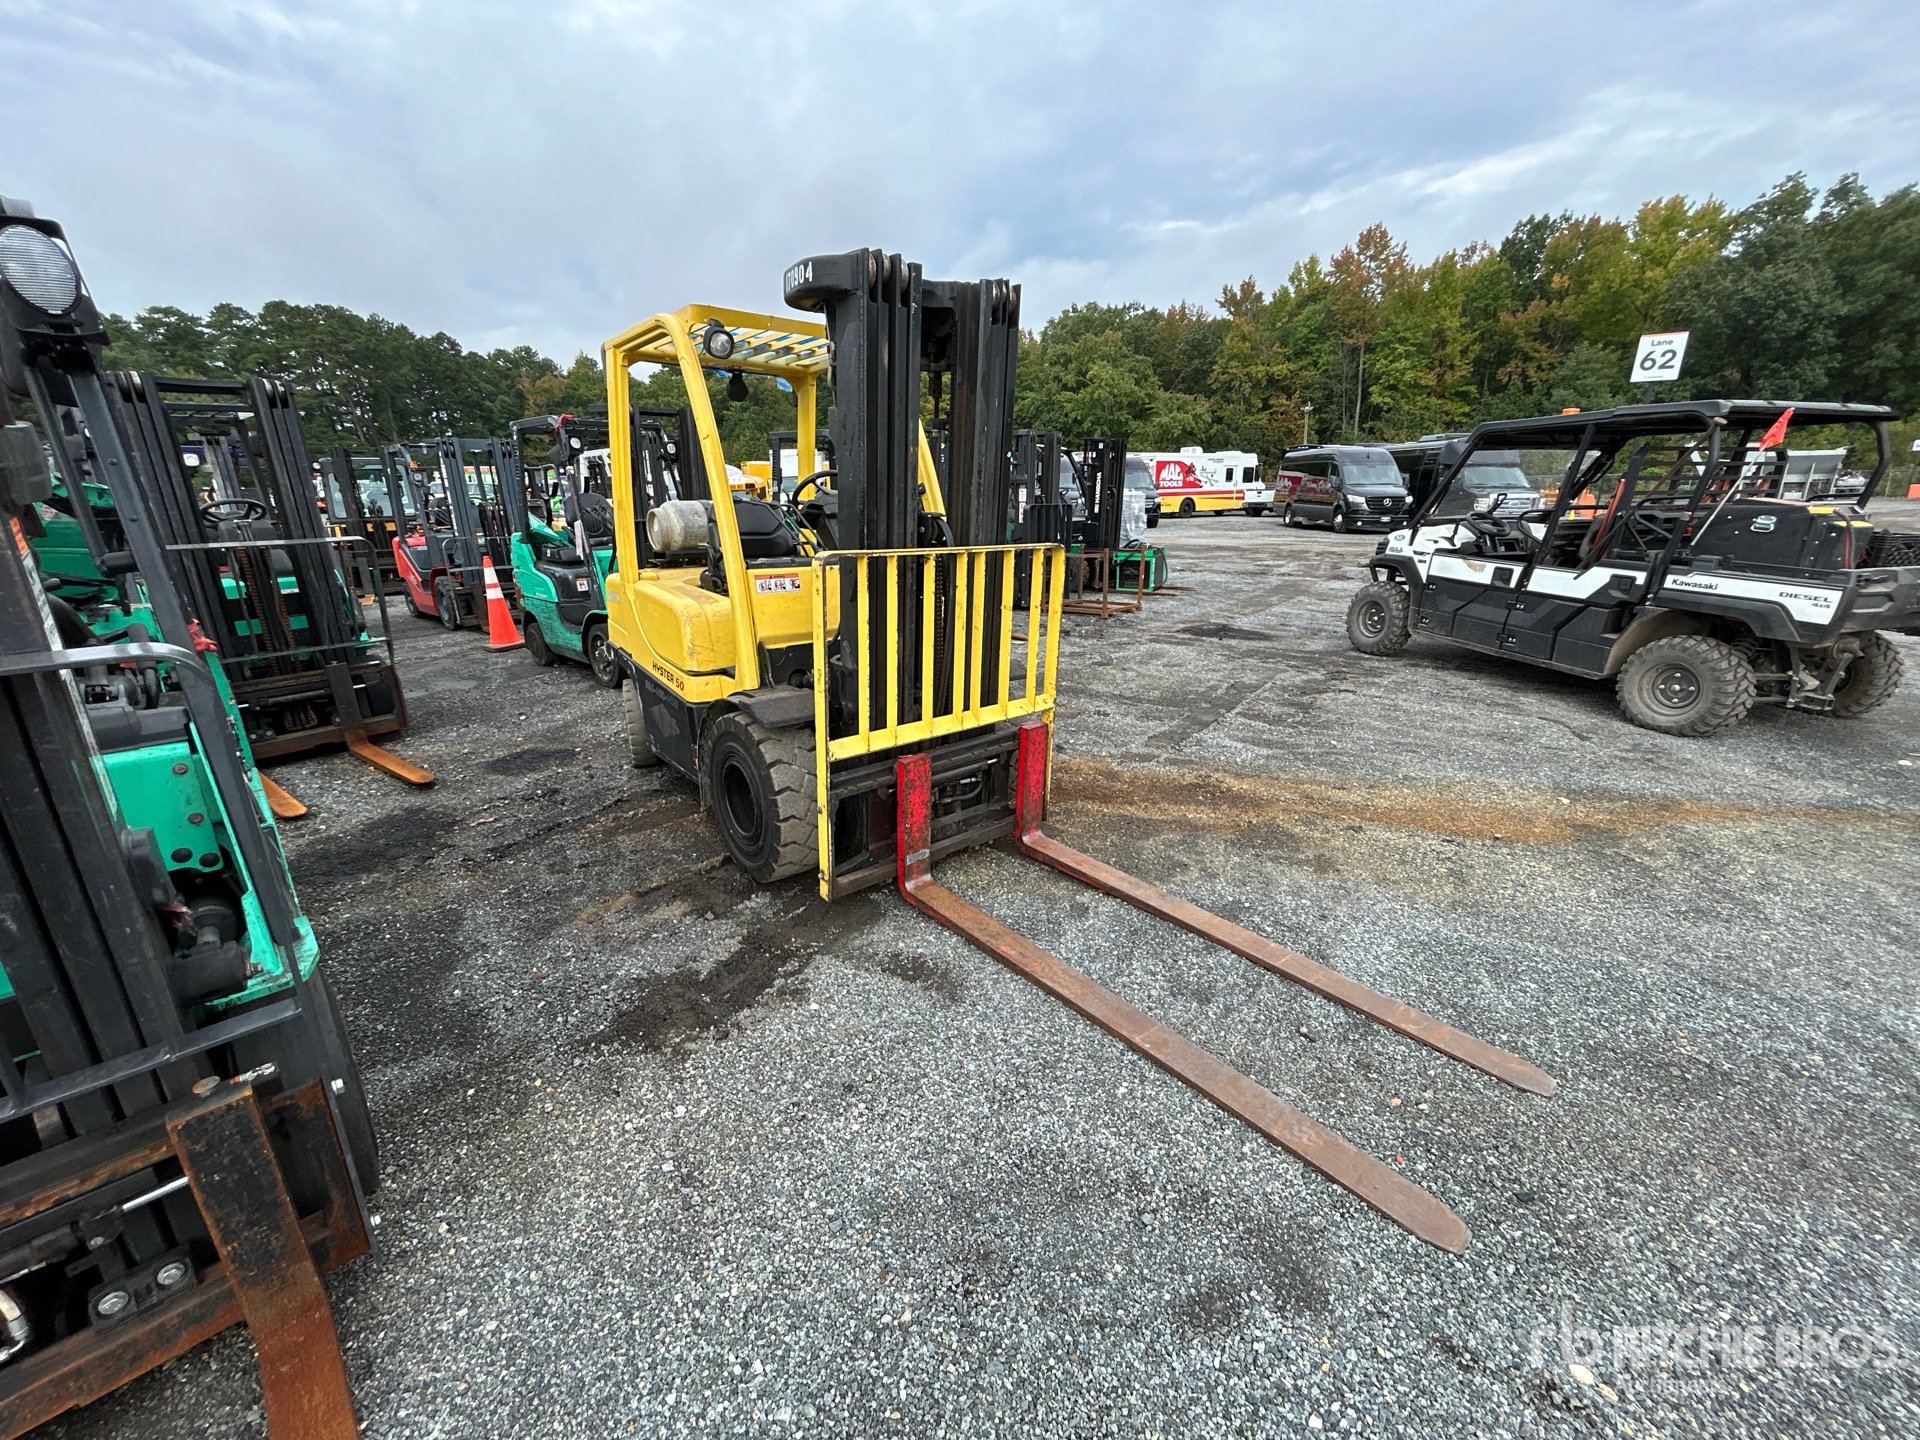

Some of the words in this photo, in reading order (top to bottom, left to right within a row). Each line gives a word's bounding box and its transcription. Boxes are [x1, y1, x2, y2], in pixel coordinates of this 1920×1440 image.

[1651, 339, 1674, 347] Lane
[1639, 349, 1677, 371] 62
[1671, 578, 1719, 591] Kawasaki
[1778, 591, 1833, 604] DIESEL
[652, 660, 675, 685] HYSTER
[675, 677, 685, 692] 50
